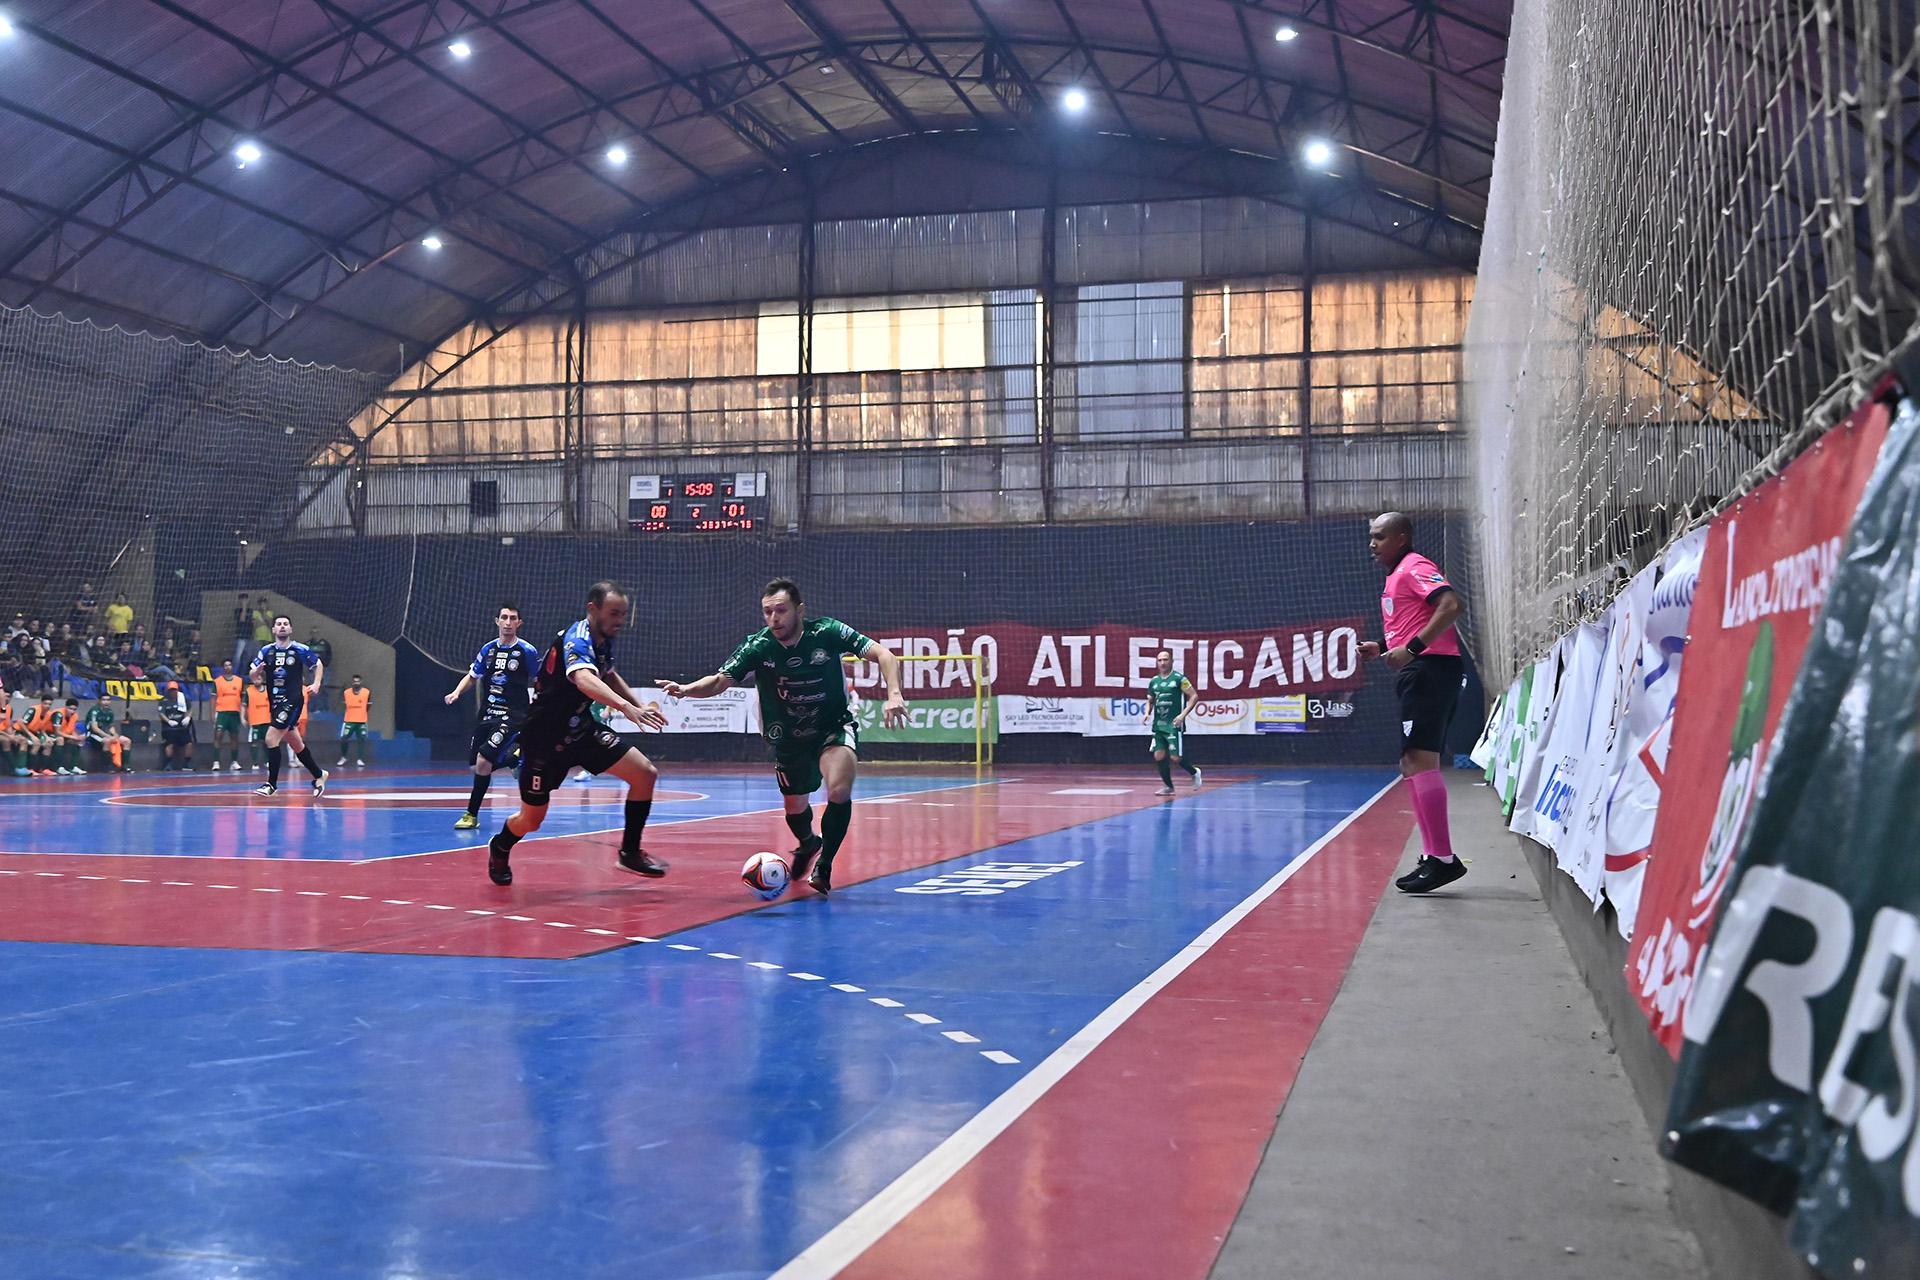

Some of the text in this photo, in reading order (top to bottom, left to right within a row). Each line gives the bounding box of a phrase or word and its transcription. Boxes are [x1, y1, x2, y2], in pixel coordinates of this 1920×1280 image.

[685, 483, 714, 496] 15:09
[651, 505, 667, 518] 00
[692, 508, 700, 518] 2
[728, 504, 745, 517] 01
[275, 657, 286, 666] 20
[495, 659, 507, 669] 98
[1028, 627, 1357, 690] ATLETICANO
[1111, 698, 1147, 717] Fibe
[1195, 702, 1240, 718] Oyshi
[532, 775, 541, 790] 8
[894, 861, 1085, 896] SEMEL
[1683, 864, 1920, 1218] RES
